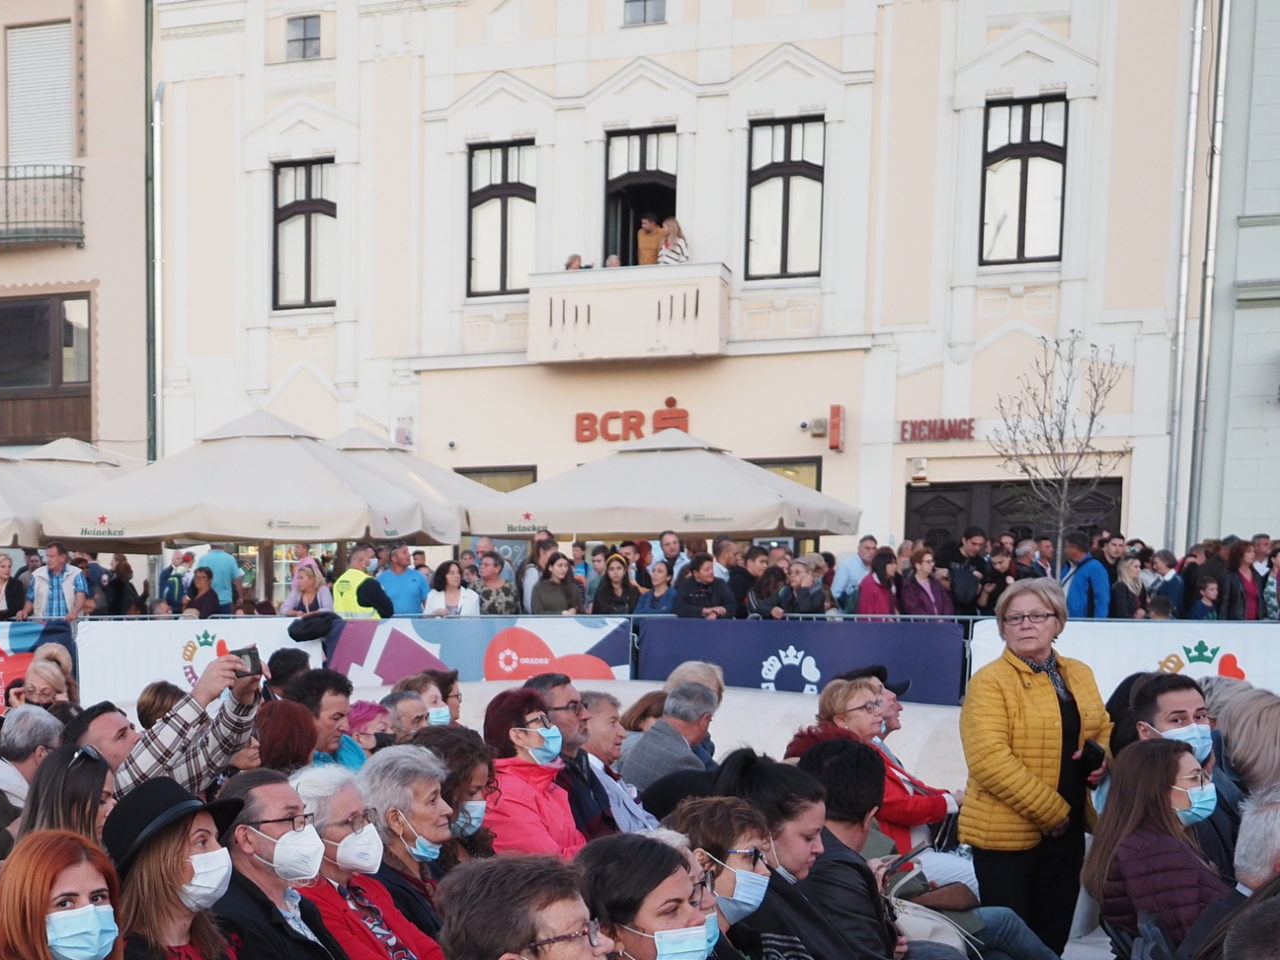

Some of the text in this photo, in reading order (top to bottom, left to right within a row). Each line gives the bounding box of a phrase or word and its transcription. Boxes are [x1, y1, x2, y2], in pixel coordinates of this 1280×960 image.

[575, 409, 645, 443] BCR
[899, 417, 976, 442] EXCHANGE
[80, 528, 125, 536] Heineken
